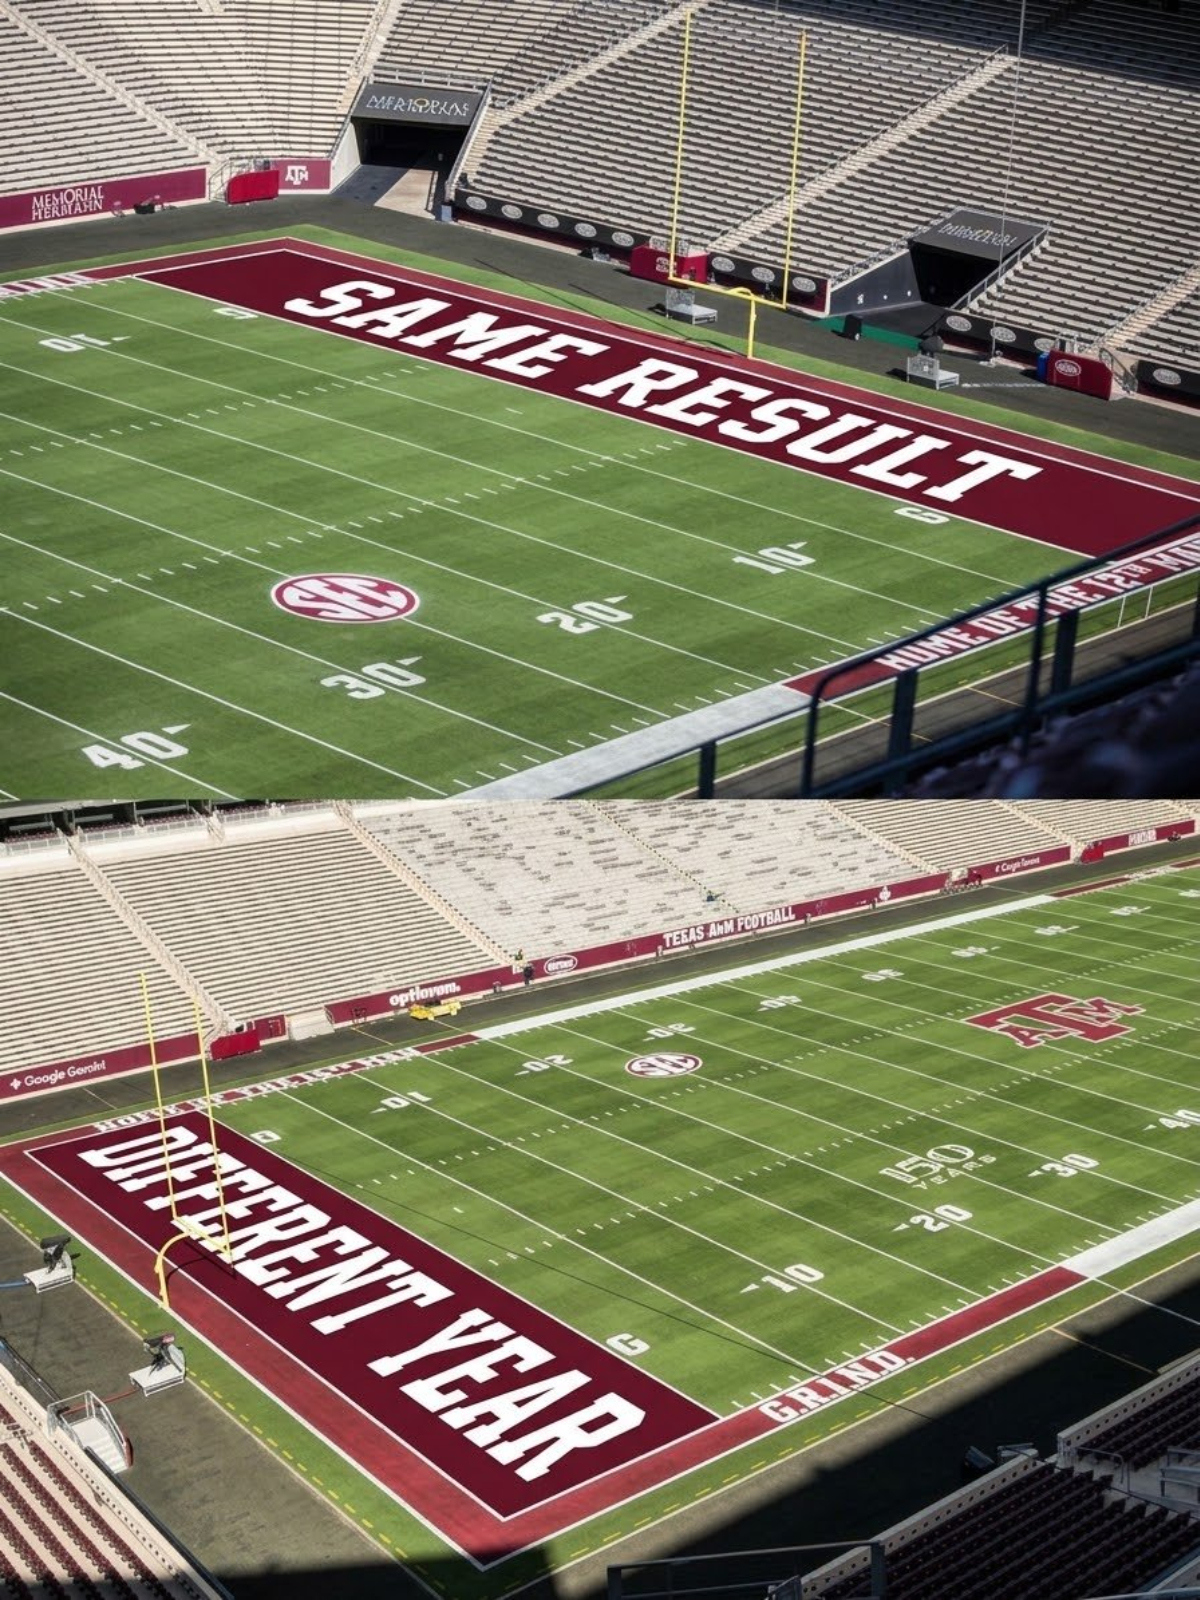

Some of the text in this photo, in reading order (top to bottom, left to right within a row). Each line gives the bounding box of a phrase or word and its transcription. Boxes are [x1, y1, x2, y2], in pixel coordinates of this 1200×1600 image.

[284, 280, 1043, 502] SAME RESULT
[732, 547, 816, 575] 10
[280, 576, 410, 620] SEC
[536, 601, 633, 634] 20
[320, 662, 427, 699] 30
[81, 731, 190, 770] 40
[1042, 1153, 1100, 1178] 30
[910, 1204, 974, 1232] 20
[761, 1263, 825, 1293] 10
[77, 1126, 646, 1482] DIFFERENT YEAR
